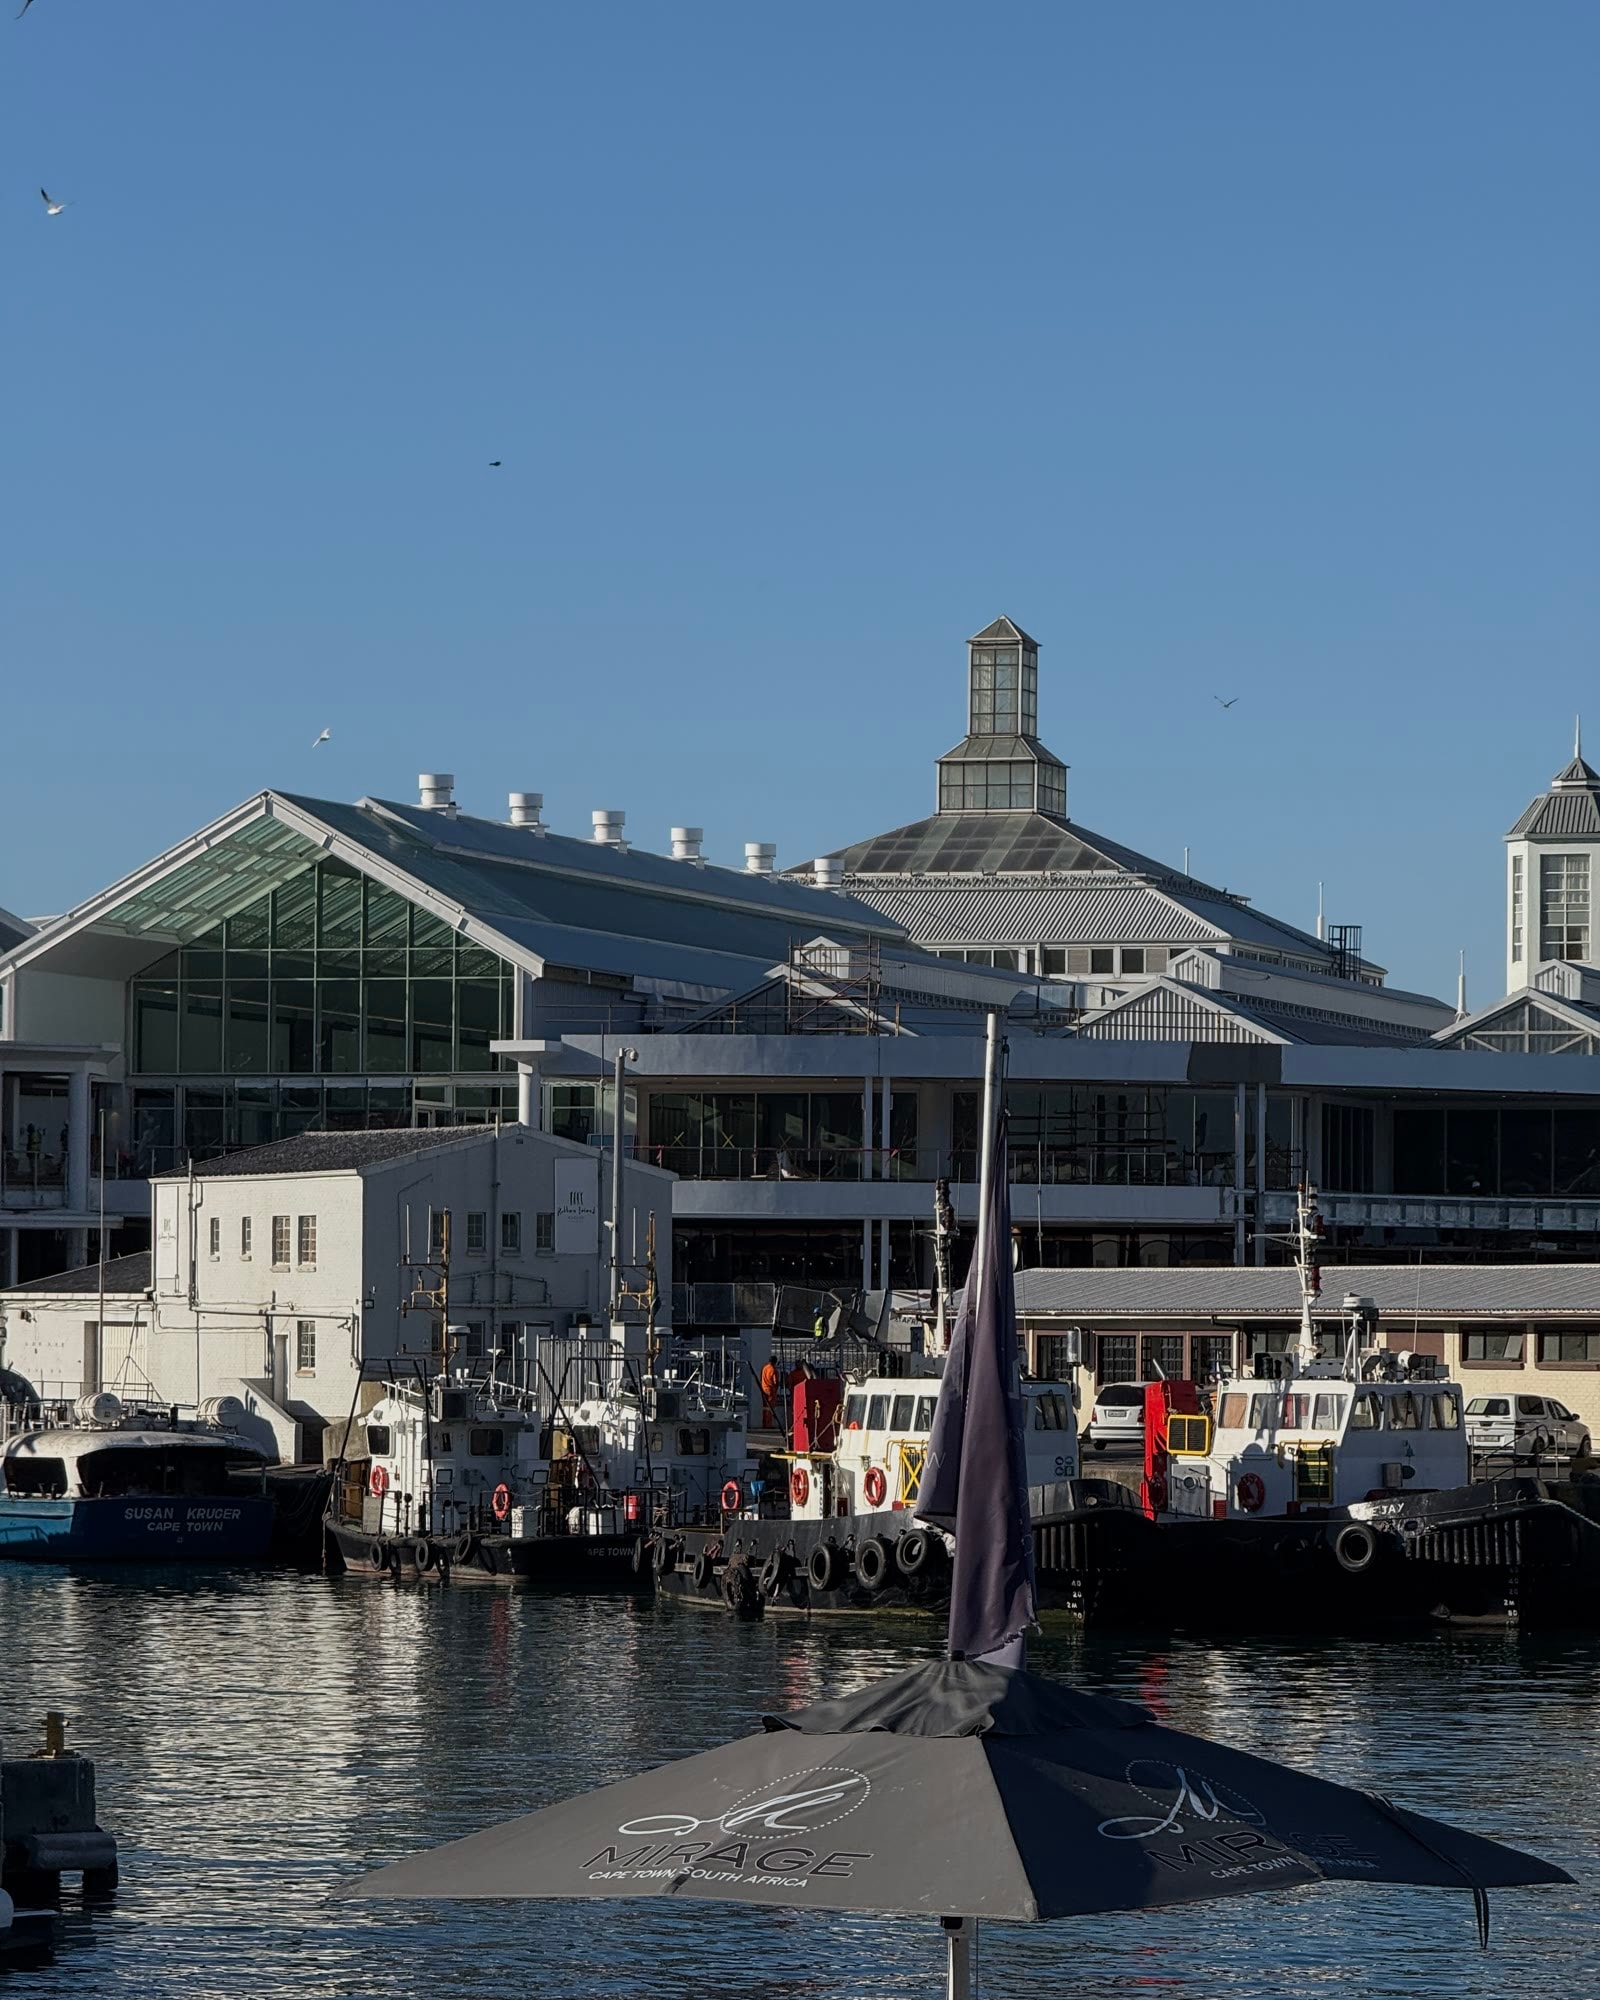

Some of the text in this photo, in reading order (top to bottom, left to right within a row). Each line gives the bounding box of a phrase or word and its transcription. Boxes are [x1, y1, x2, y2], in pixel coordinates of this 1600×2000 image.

[124, 1507, 241, 1520] SUSAN KRUGER
[147, 1521, 223, 1532] CAPE TOWN
[585, 1547, 634, 1556] APE TOWN
[579, 1841, 874, 1878] MIRAGE
[589, 1870, 632, 1880] CAPE
[679, 1866, 743, 1882] SOUTH
[743, 1875, 808, 1888] AFRICA
[1210, 1866, 1253, 1879] CAPE
